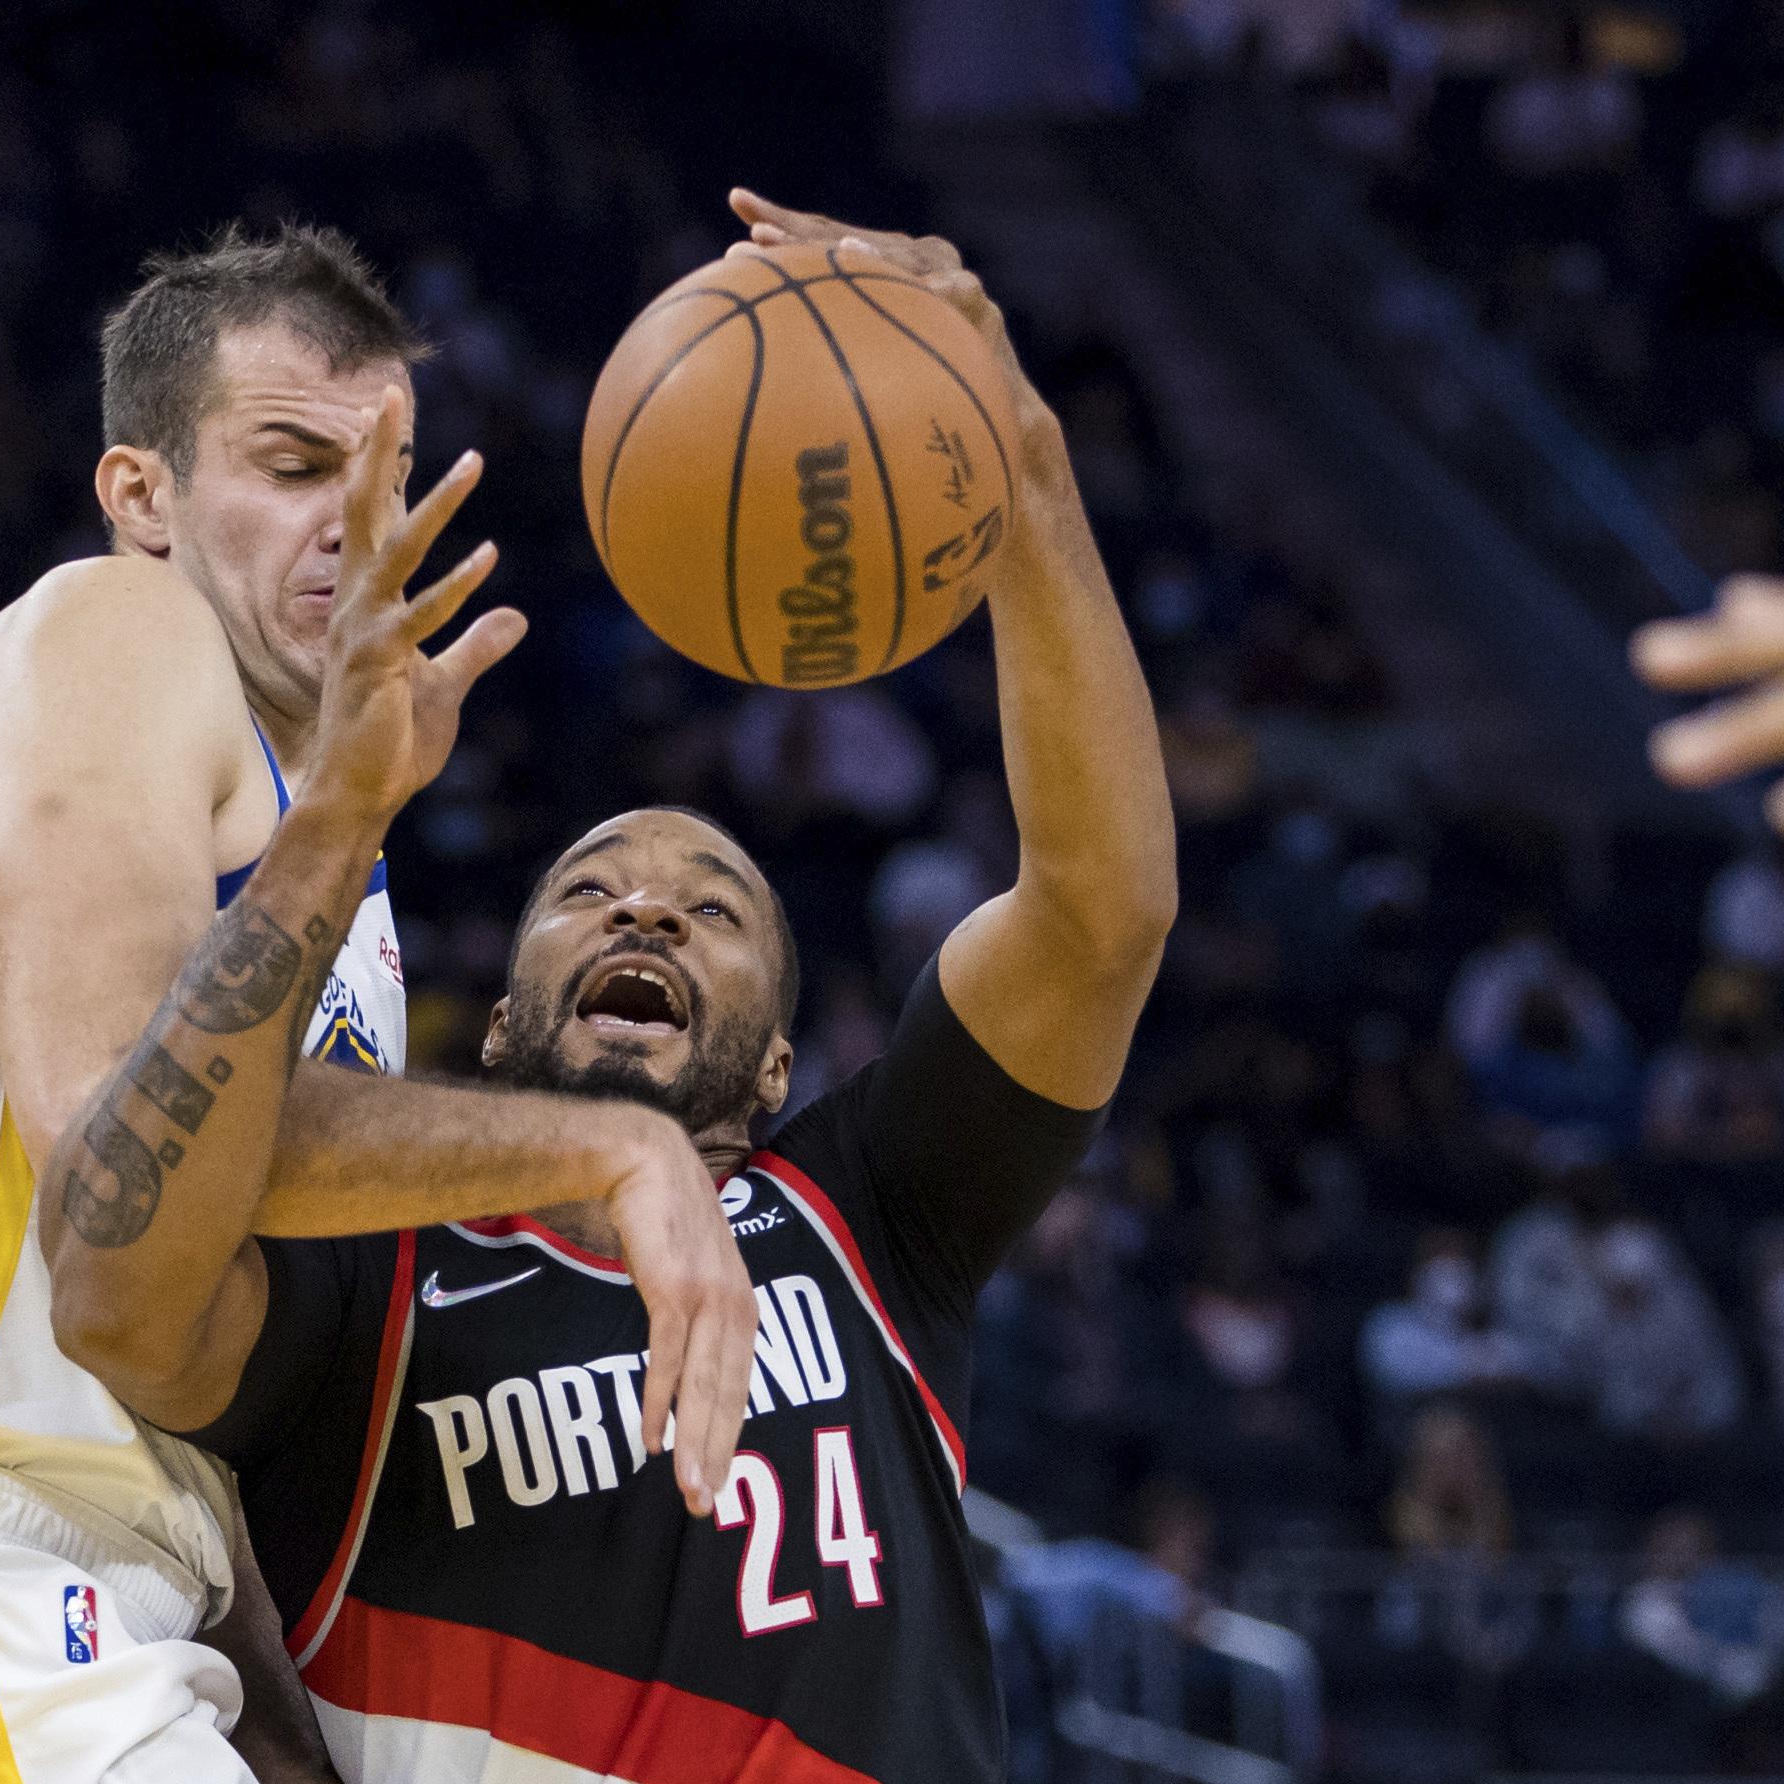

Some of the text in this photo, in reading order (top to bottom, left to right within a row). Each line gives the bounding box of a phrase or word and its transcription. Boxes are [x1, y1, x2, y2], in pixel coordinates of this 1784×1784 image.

[777, 441, 861, 684] Wilson
[416, 1274, 848, 1530] PORTND
[713, 1425, 884, 1639] 24
